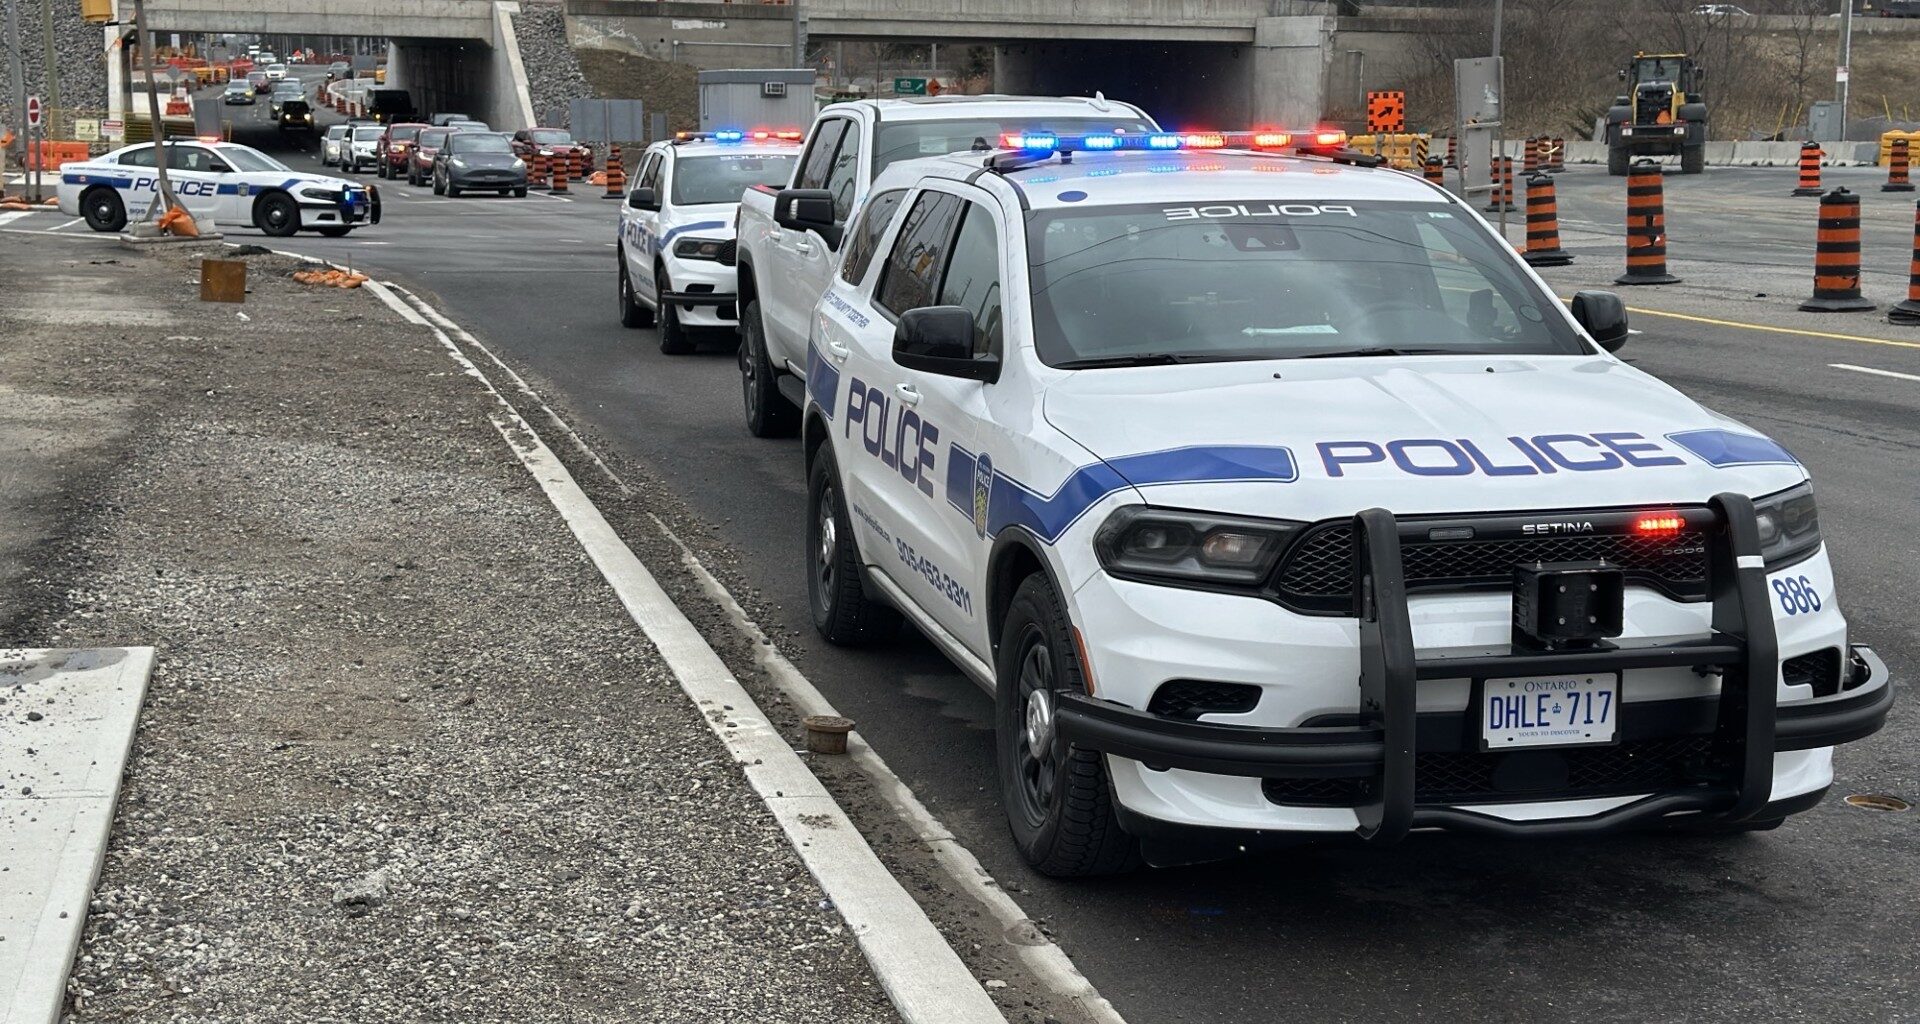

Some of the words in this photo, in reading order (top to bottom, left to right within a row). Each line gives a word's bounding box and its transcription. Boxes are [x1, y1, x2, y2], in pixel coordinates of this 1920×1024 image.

[845, 376, 939, 499] POLICE
[1315, 432, 1687, 477] POLICE
[1522, 521, 1594, 535] SETINA
[1662, 546, 1705, 556] DODG
[896, 537, 973, 617] 905-453-3311
[1771, 575, 1821, 616] 886
[1524, 680, 1577, 692] ONTARIO
[1490, 693, 1551, 729] DHLE
[1567, 690, 1612, 725] 717
